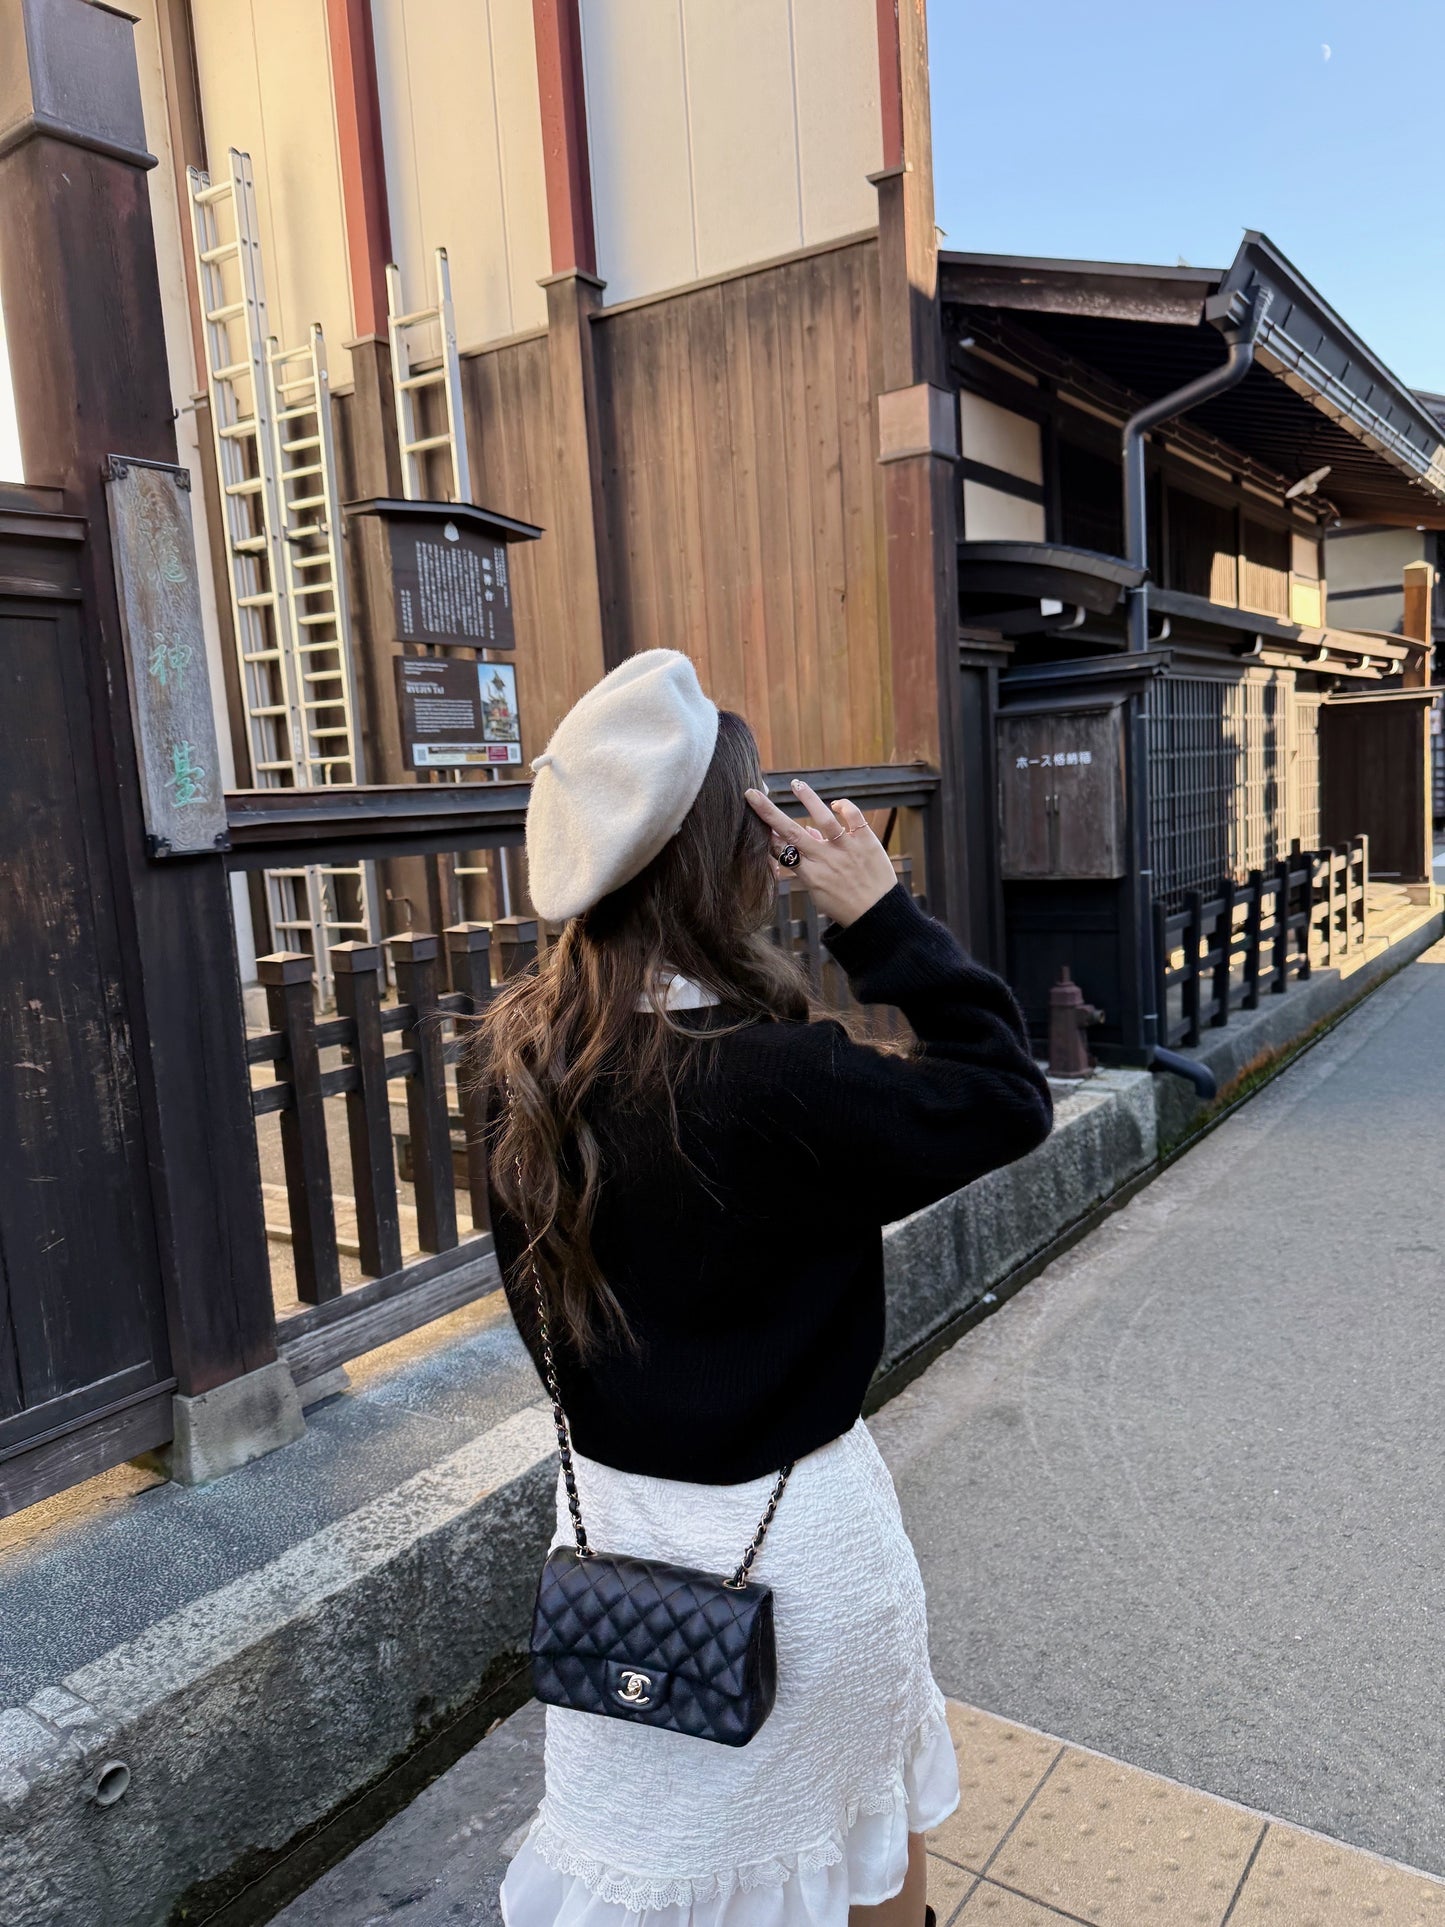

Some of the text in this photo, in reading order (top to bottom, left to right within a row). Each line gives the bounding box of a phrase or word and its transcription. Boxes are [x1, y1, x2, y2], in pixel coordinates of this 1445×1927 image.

[1016, 751, 1092, 769] ホース格納箱
